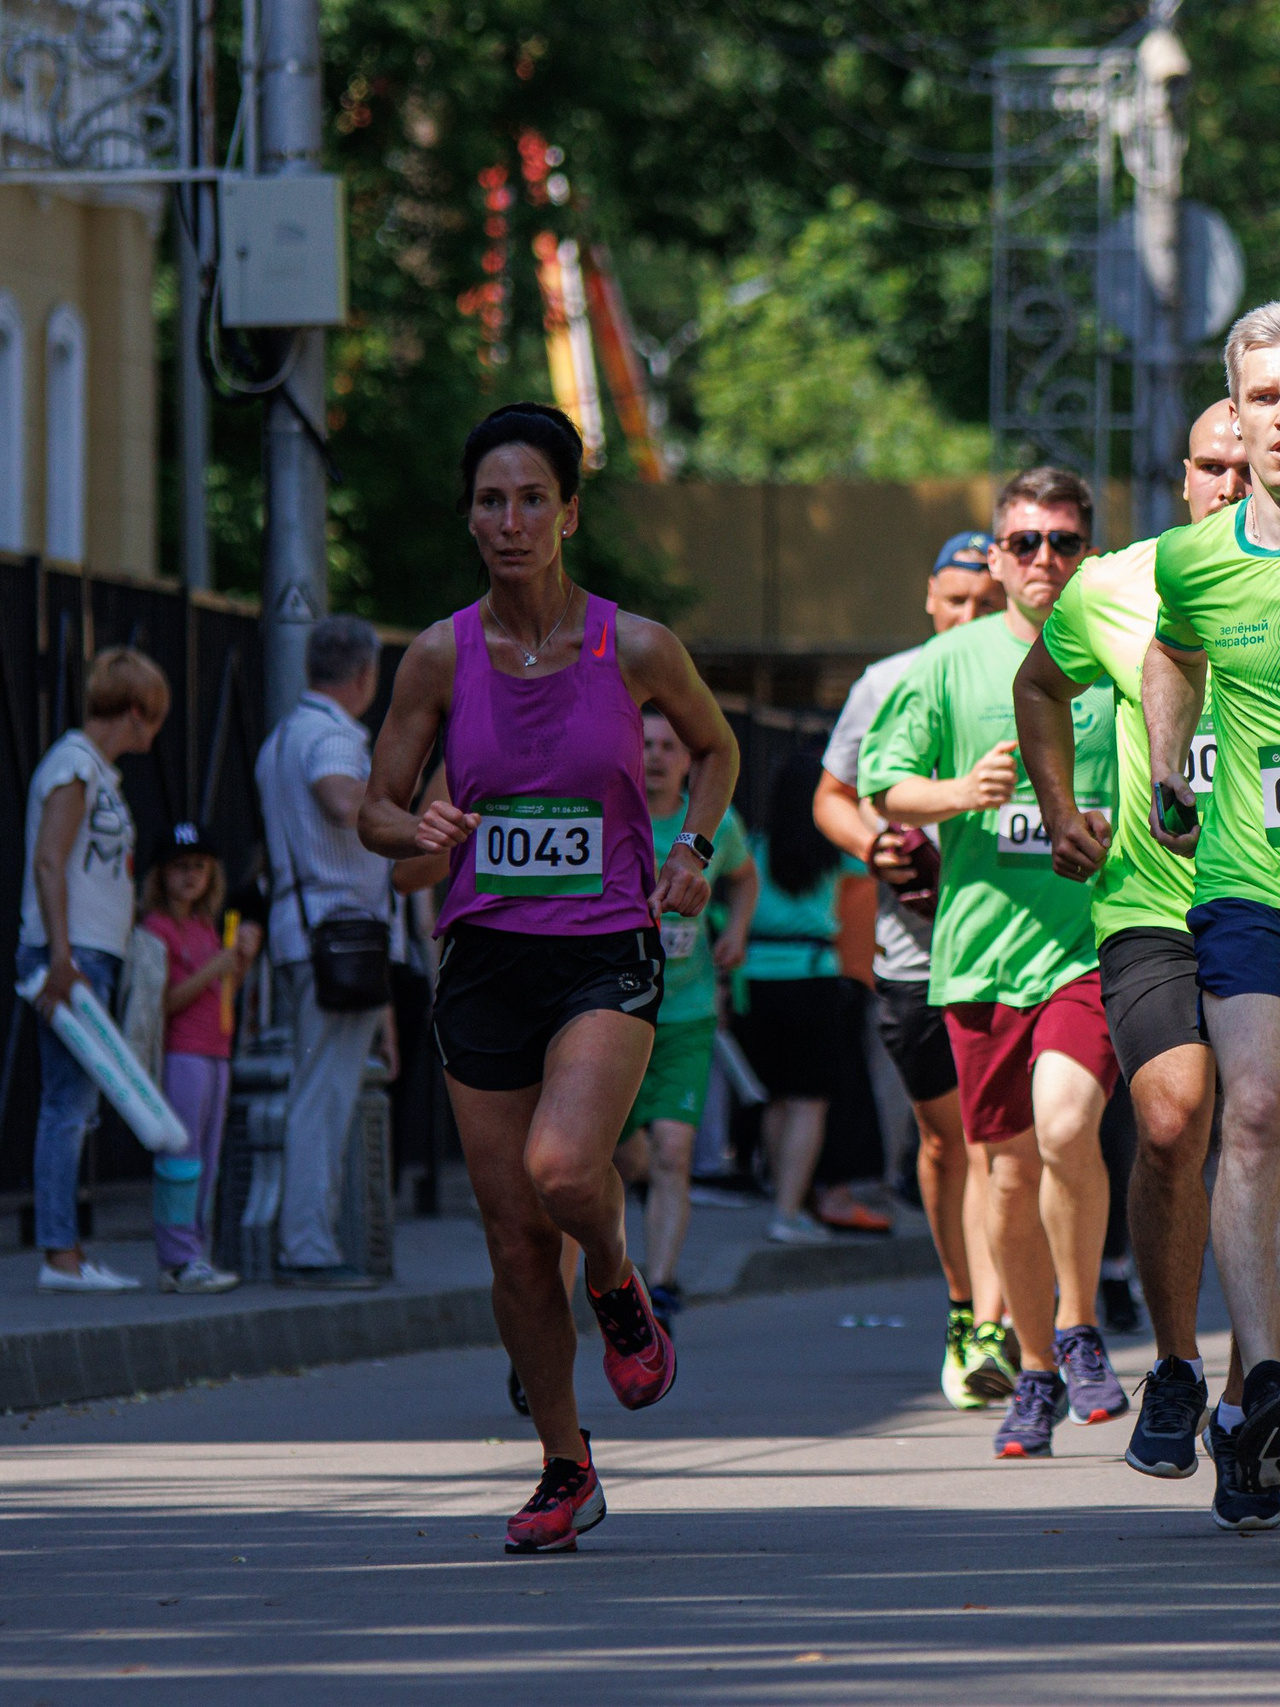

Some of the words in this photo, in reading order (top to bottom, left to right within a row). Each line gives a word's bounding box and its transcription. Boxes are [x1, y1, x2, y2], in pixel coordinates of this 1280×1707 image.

[1220, 619, 1268, 635] зелёный
[1215, 634, 1265, 649] марафон
[487, 825, 590, 867] 0043
